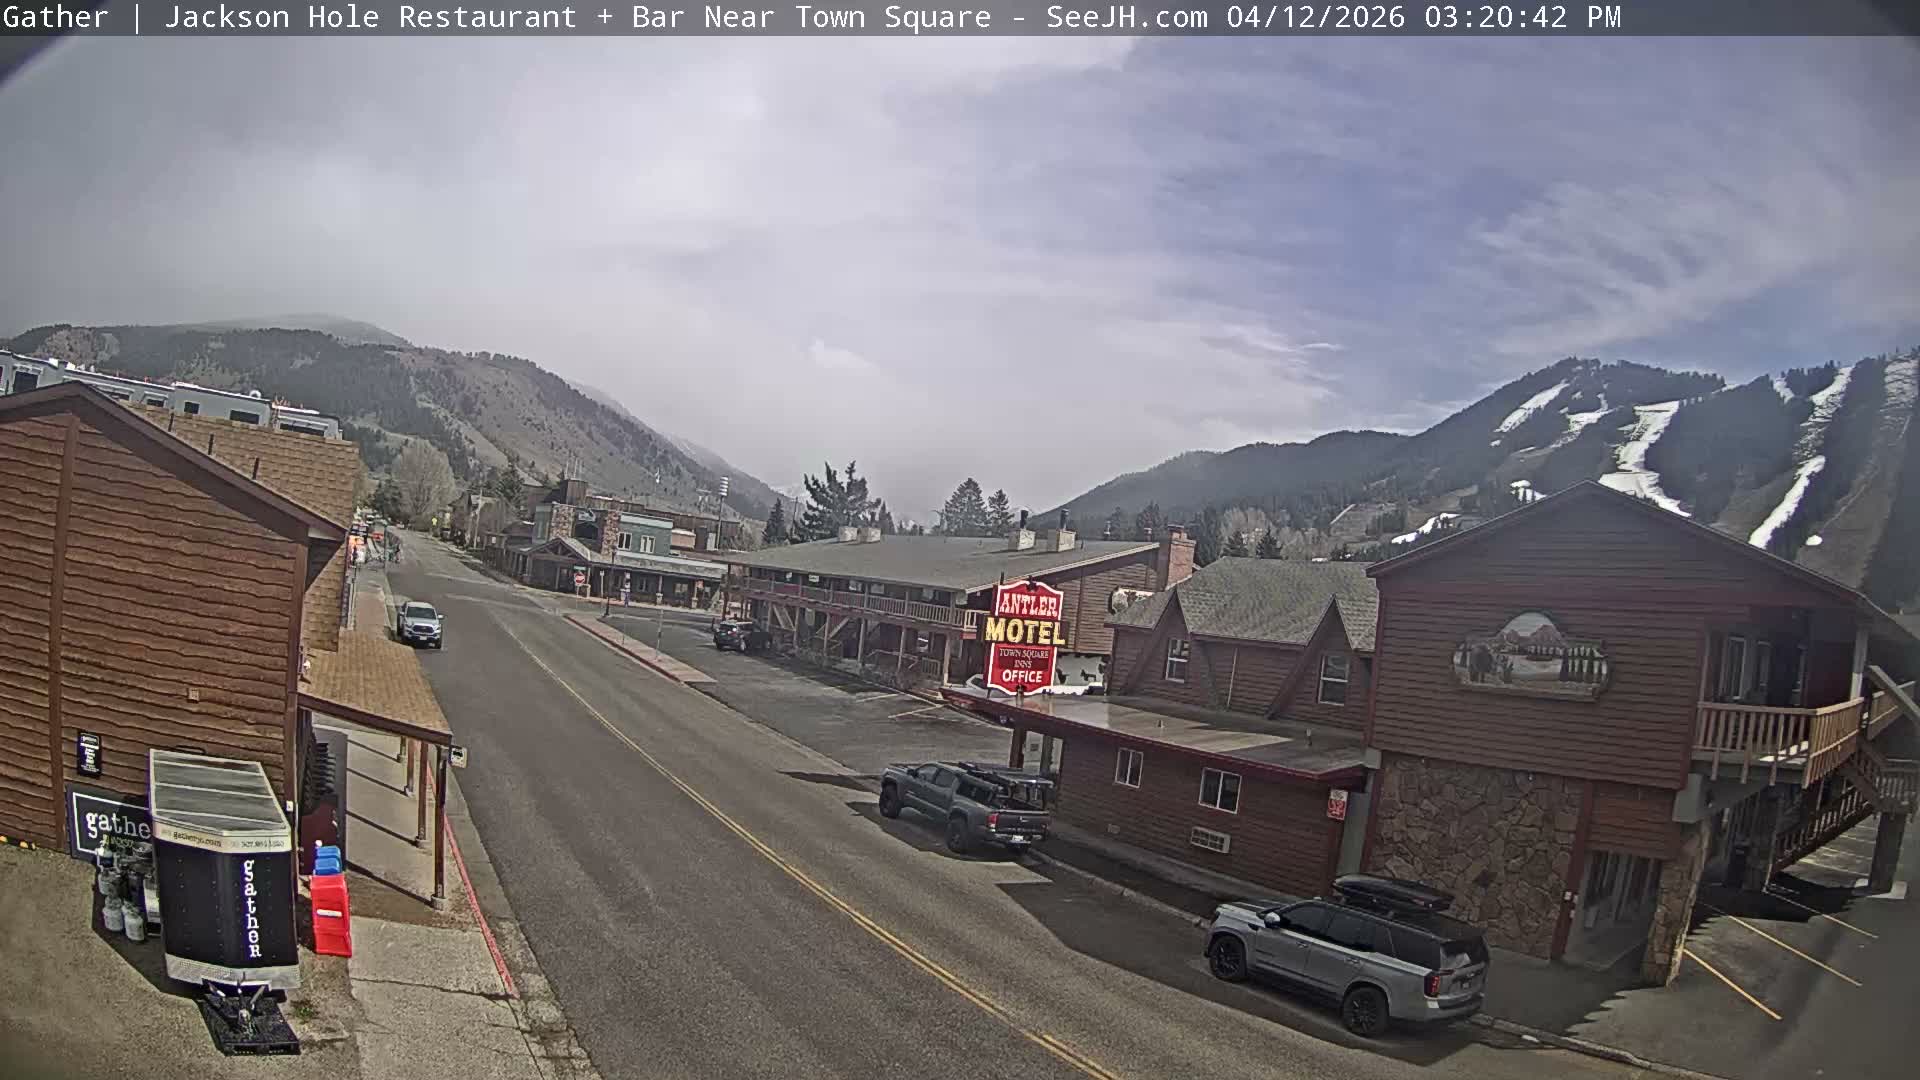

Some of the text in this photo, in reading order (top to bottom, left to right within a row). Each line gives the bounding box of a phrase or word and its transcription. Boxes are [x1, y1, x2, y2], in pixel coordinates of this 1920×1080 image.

[1000, 593, 1057, 616] ANTLER
[985, 617, 1065, 645] MOTEL
[1000, 648, 1049, 661] TOWN SQUARE
[1014, 659, 1033, 669] INNS
[1002, 669, 1043, 683] OFFICE
[85, 812, 151, 840] gathe
